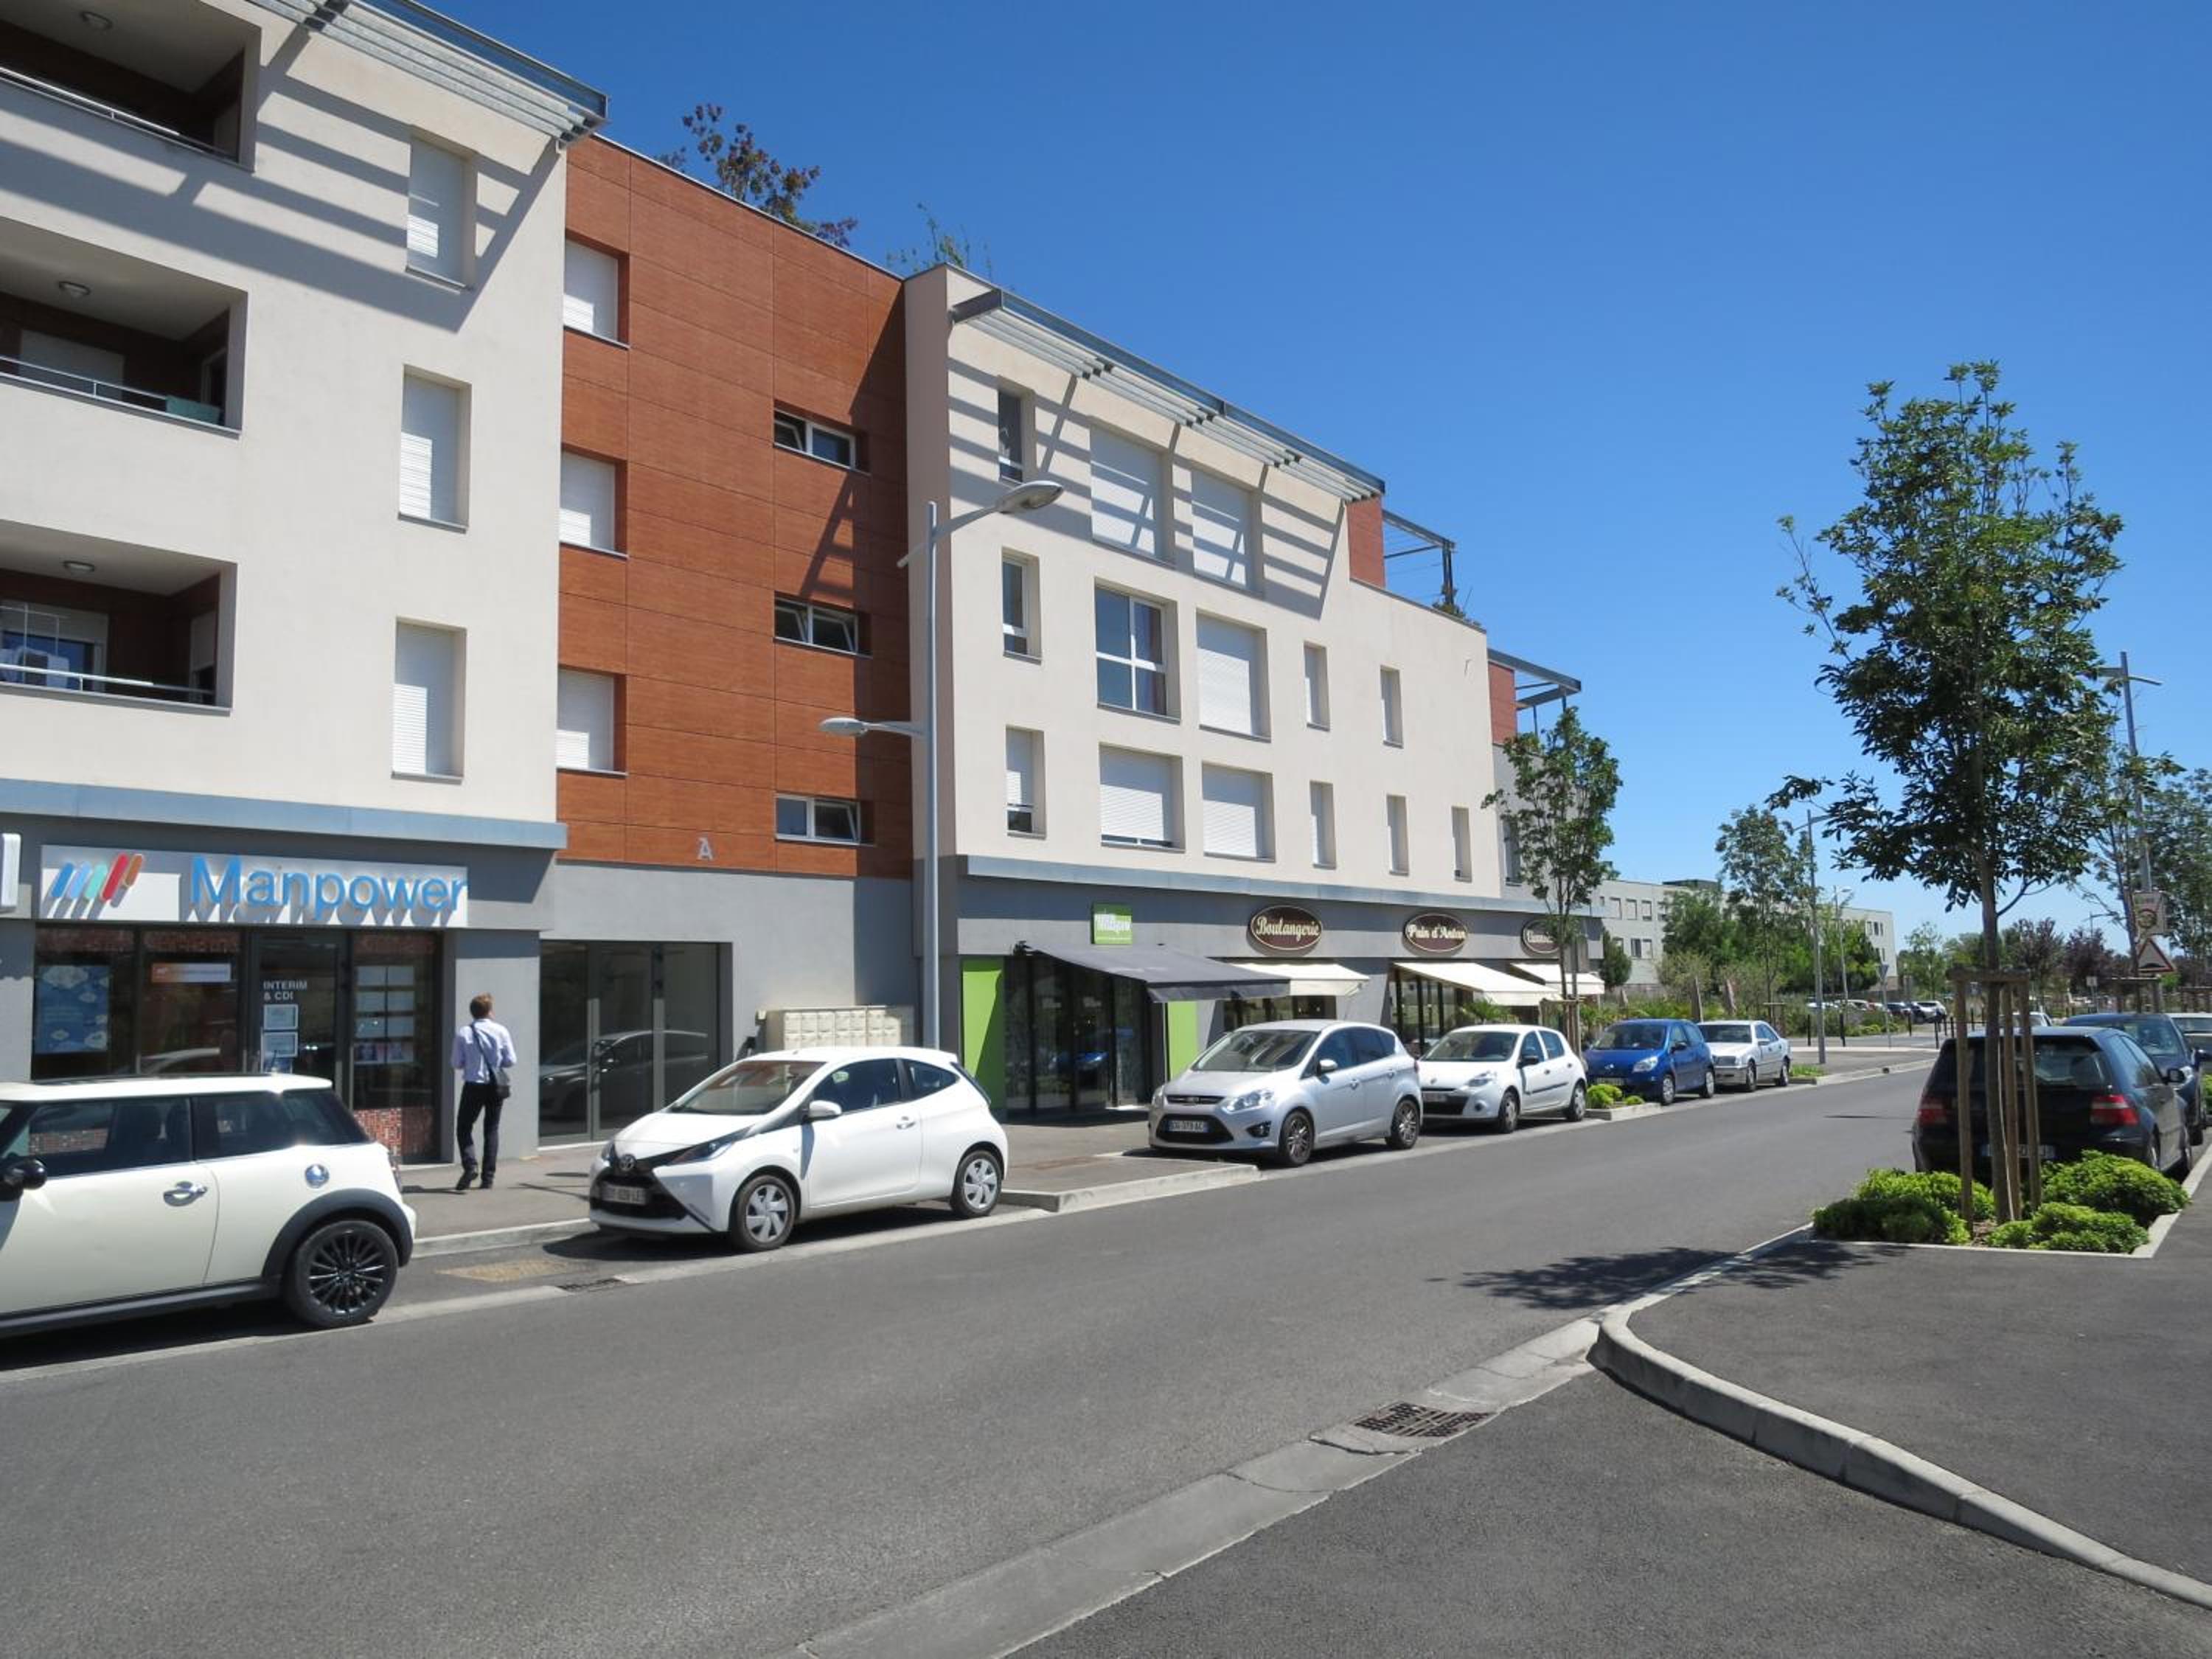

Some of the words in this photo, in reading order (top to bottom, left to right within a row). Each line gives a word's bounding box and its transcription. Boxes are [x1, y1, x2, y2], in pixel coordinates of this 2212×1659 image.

[698, 837, 714, 860] A
[190, 855, 466, 920] Manpower
[1256, 916, 1319, 942] Boulangerie
[1407, 924, 1430, 939] Pain
[263, 980, 307, 990] INTERIM
[263, 991, 271, 1001] &
[274, 991, 294, 1001] CDI
